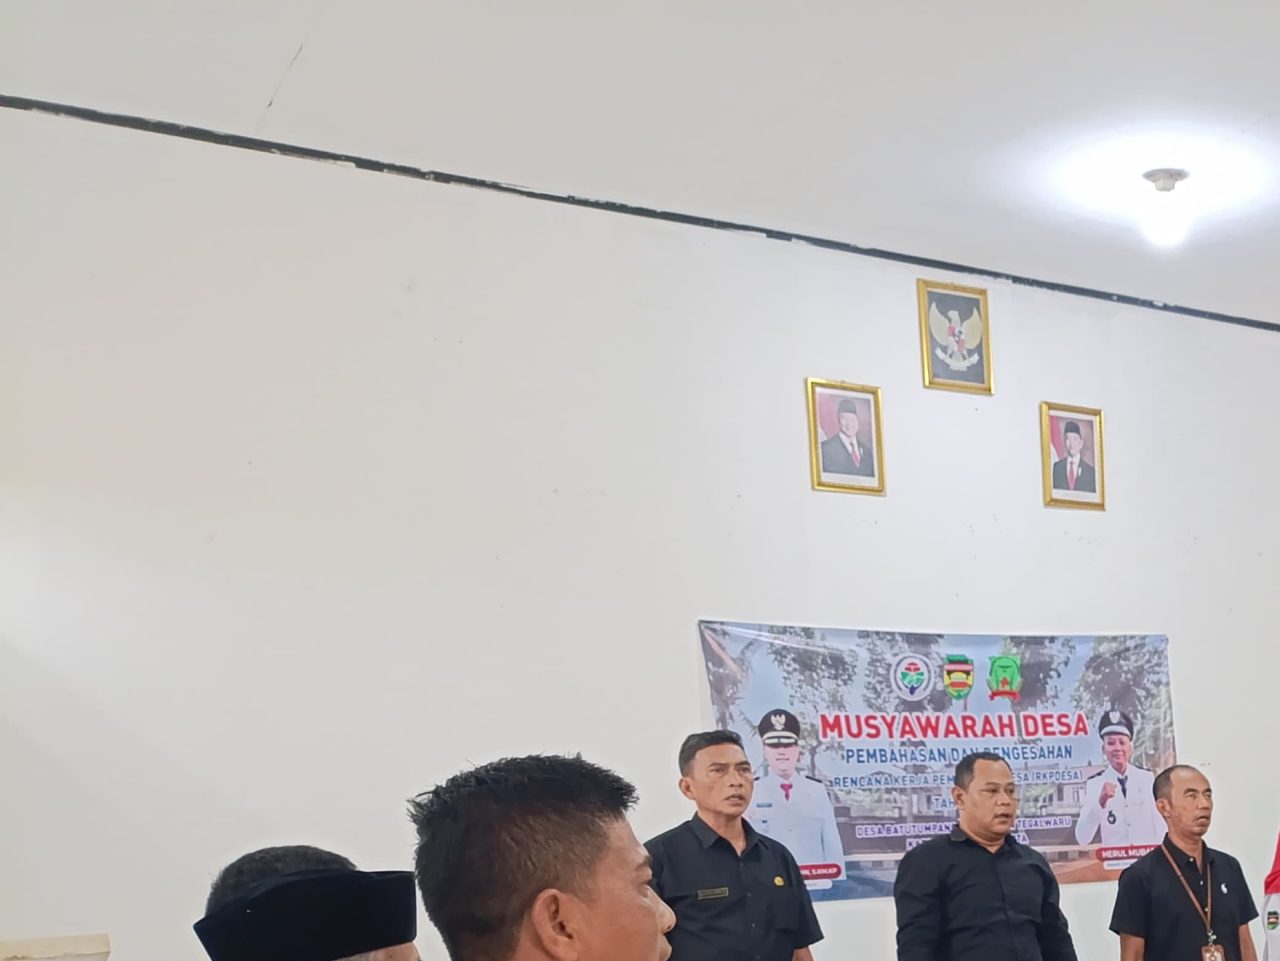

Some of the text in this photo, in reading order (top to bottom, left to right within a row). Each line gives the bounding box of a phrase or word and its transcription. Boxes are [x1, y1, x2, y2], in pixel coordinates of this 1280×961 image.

[820, 712, 1089, 739] MUSYAWARAH DESA
[846, 747, 947, 764] PEMBAHASAN
[834, 776, 892, 788] RENCANA
[894, 774, 929, 786] KERJA
[856, 825, 884, 837] DESA
[1017, 816, 1071, 829] TEGALWARU
